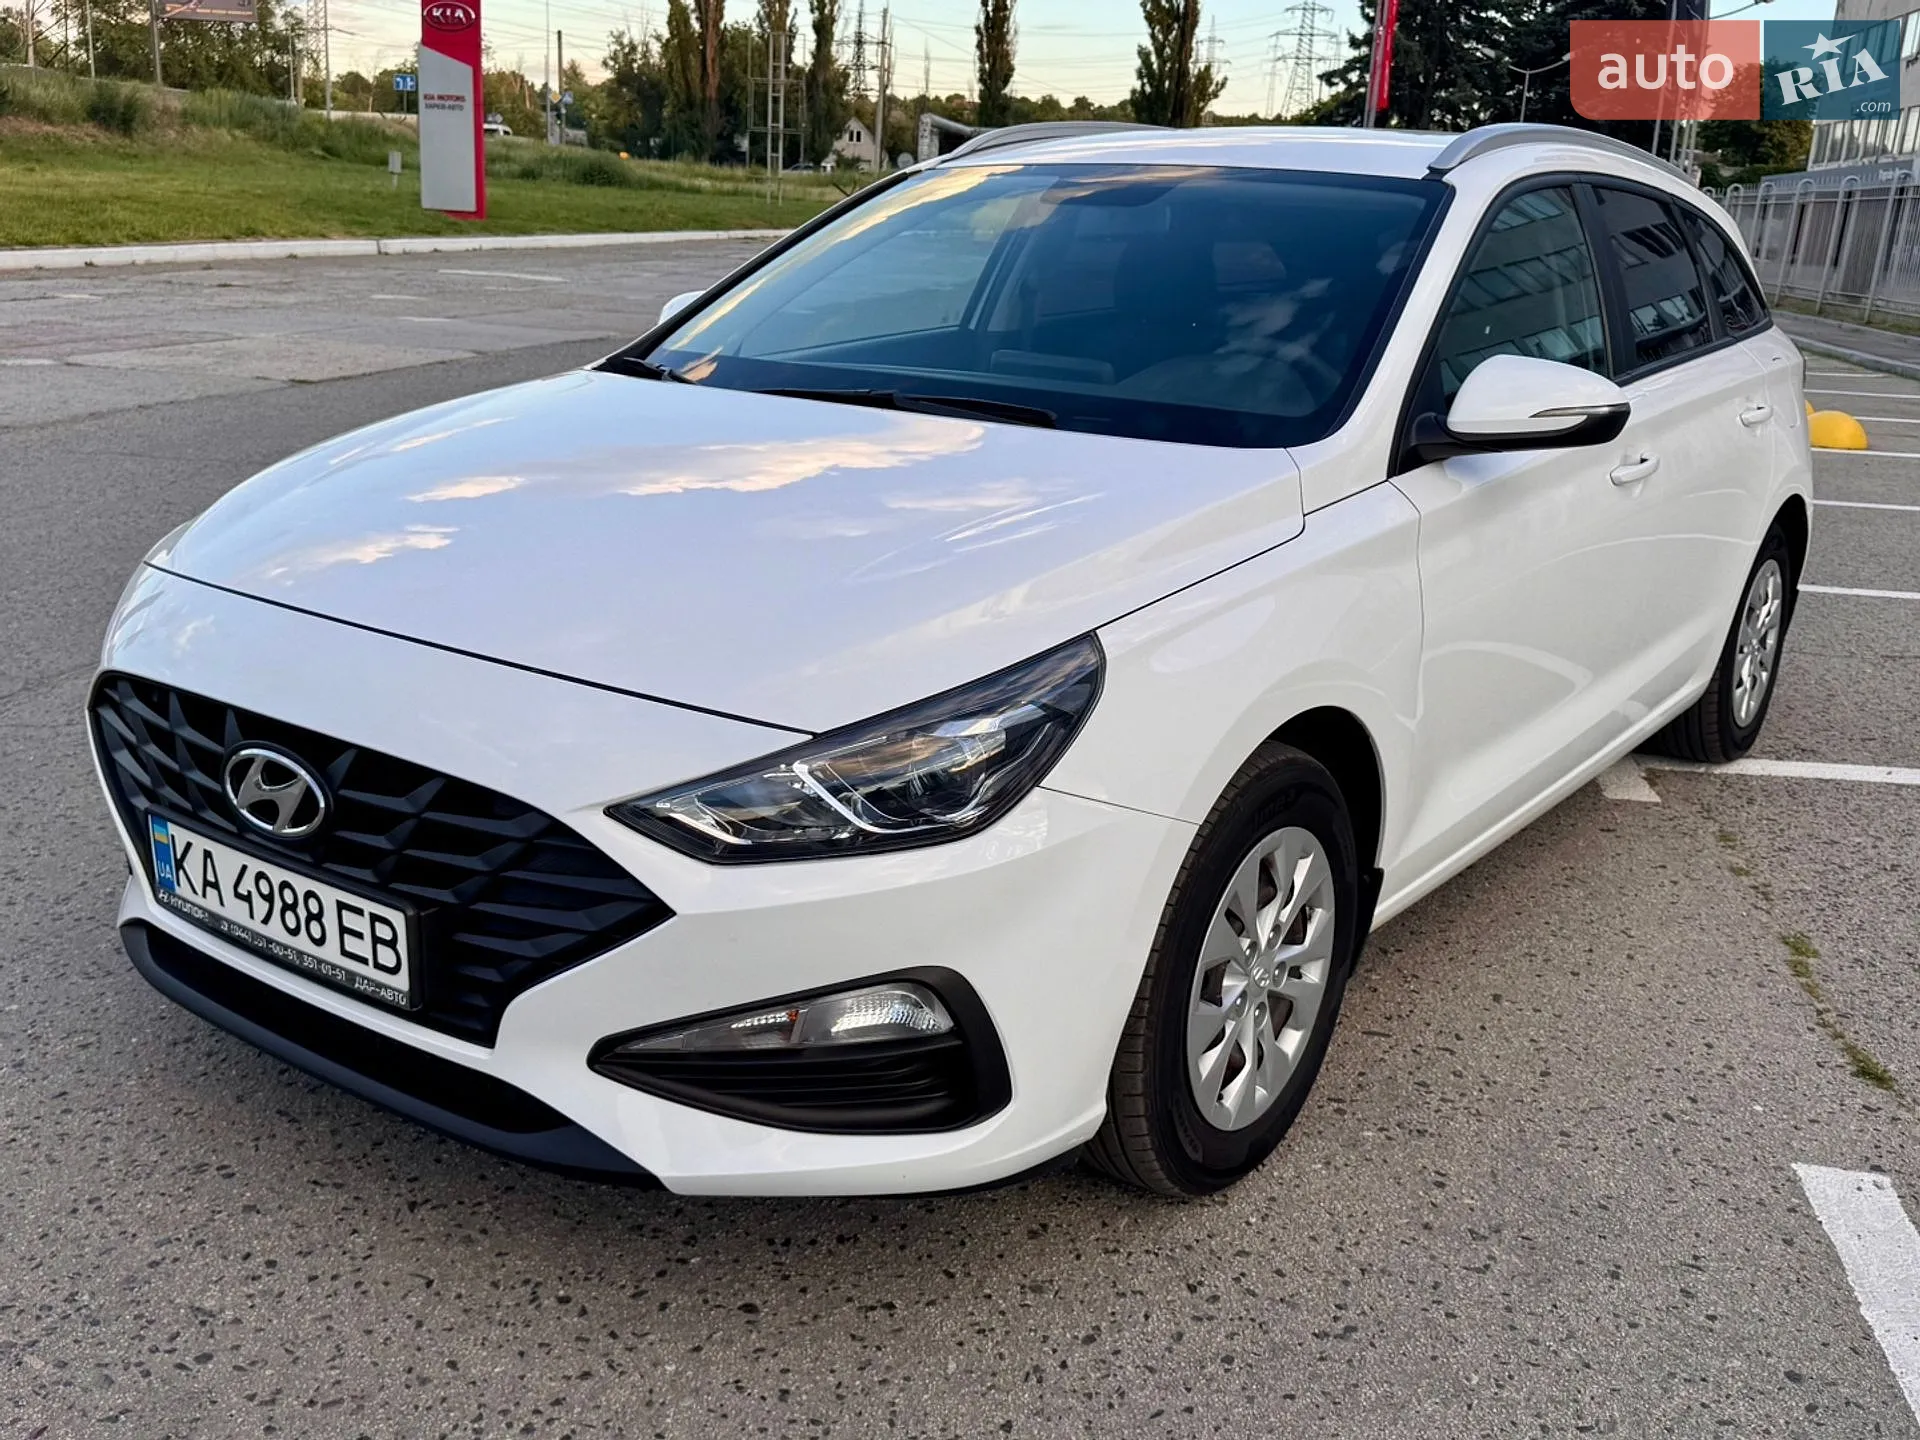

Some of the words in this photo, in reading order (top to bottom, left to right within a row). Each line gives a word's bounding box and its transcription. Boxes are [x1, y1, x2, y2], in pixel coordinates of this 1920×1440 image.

[432, 7, 467, 25] KIA
[424, 93, 435, 101] KIA
[437, 94, 467, 102] MOTORS
[158, 861, 173, 880] UA
[171, 834, 225, 907] KA
[233, 864, 327, 947] 4988
[336, 899, 403, 976] EB
